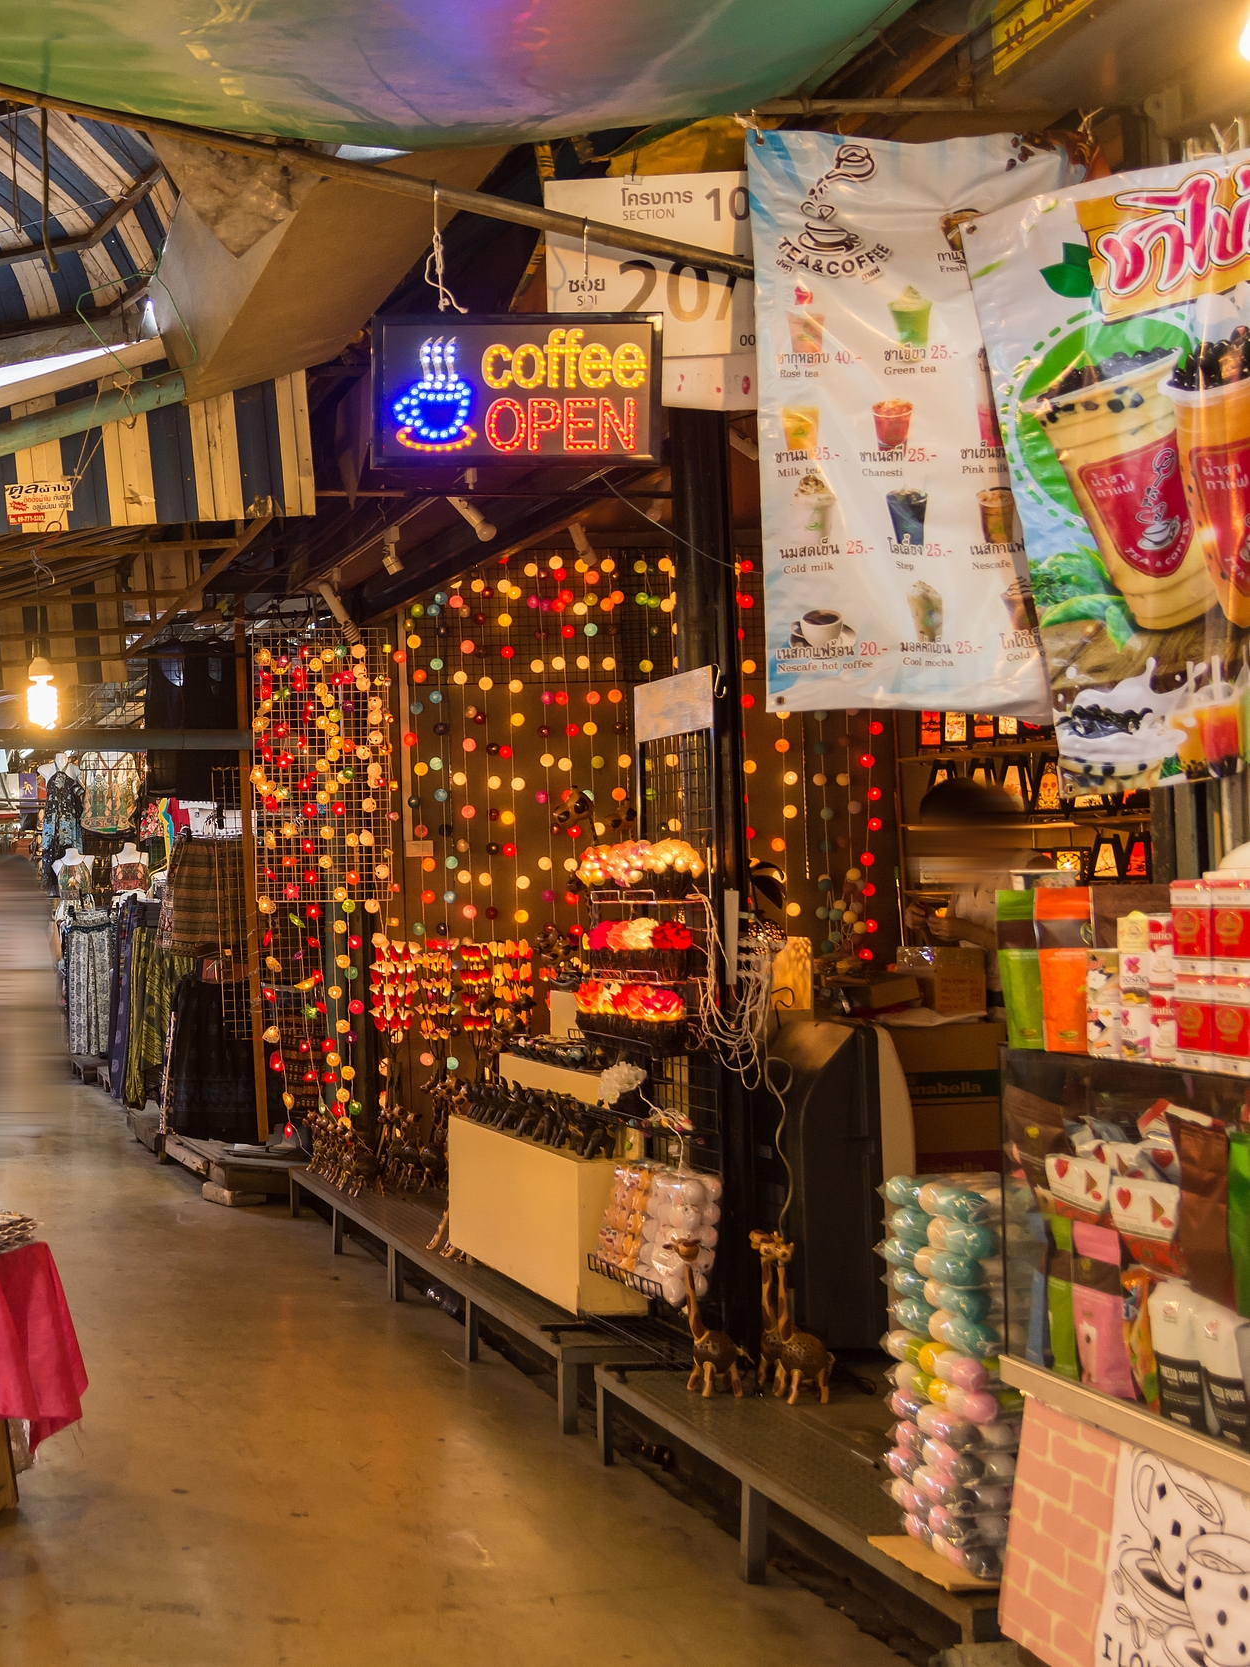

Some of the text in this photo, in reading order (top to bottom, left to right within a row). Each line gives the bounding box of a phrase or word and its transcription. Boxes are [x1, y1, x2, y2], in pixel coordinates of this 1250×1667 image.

[621, 186, 750, 222] โครงการ 10
[622, 208, 675, 221] SECTION
[939, 264, 966, 273] Fresh
[568, 278, 606, 293] ซอย
[577, 295, 598, 306] SOI
[481, 328, 647, 389] coffee
[884, 344, 926, 361] ชาเขียว
[930, 345, 959, 360] 25.-
[777, 350, 862, 369] ชากุหลาบ 40.-
[779, 369, 819, 378] Rose tea
[884, 364, 937, 375] Green tea
[485, 397, 636, 451] OPEN
[775, 446, 840, 463] ชานม 25.-
[907, 447, 937, 463] 25.-
[777, 466, 821, 477] Milk tea
[861, 467, 903, 477] Chanesti
[962, 463, 1008, 474] Pink milk
[1096, 481, 1135, 498] กาแฟ
[779, 537, 874, 559] นมสดเย็น 25.-
[925, 543, 952, 557] 25.-
[1124, 547, 1150, 566] TEA
[783, 561, 834, 574] Cold milk
[896, 561, 914, 571] Step
[972, 559, 1011, 570] Nescafe
[776, 639, 888, 660] เนสกาแฟร้อน 20.-
[956, 640, 983, 655] 25.-
[902, 657, 954, 667] Cool mocha
[1006, 651, 1030, 661] Cold
[777, 660, 873, 673] Nescafe hot coffee
